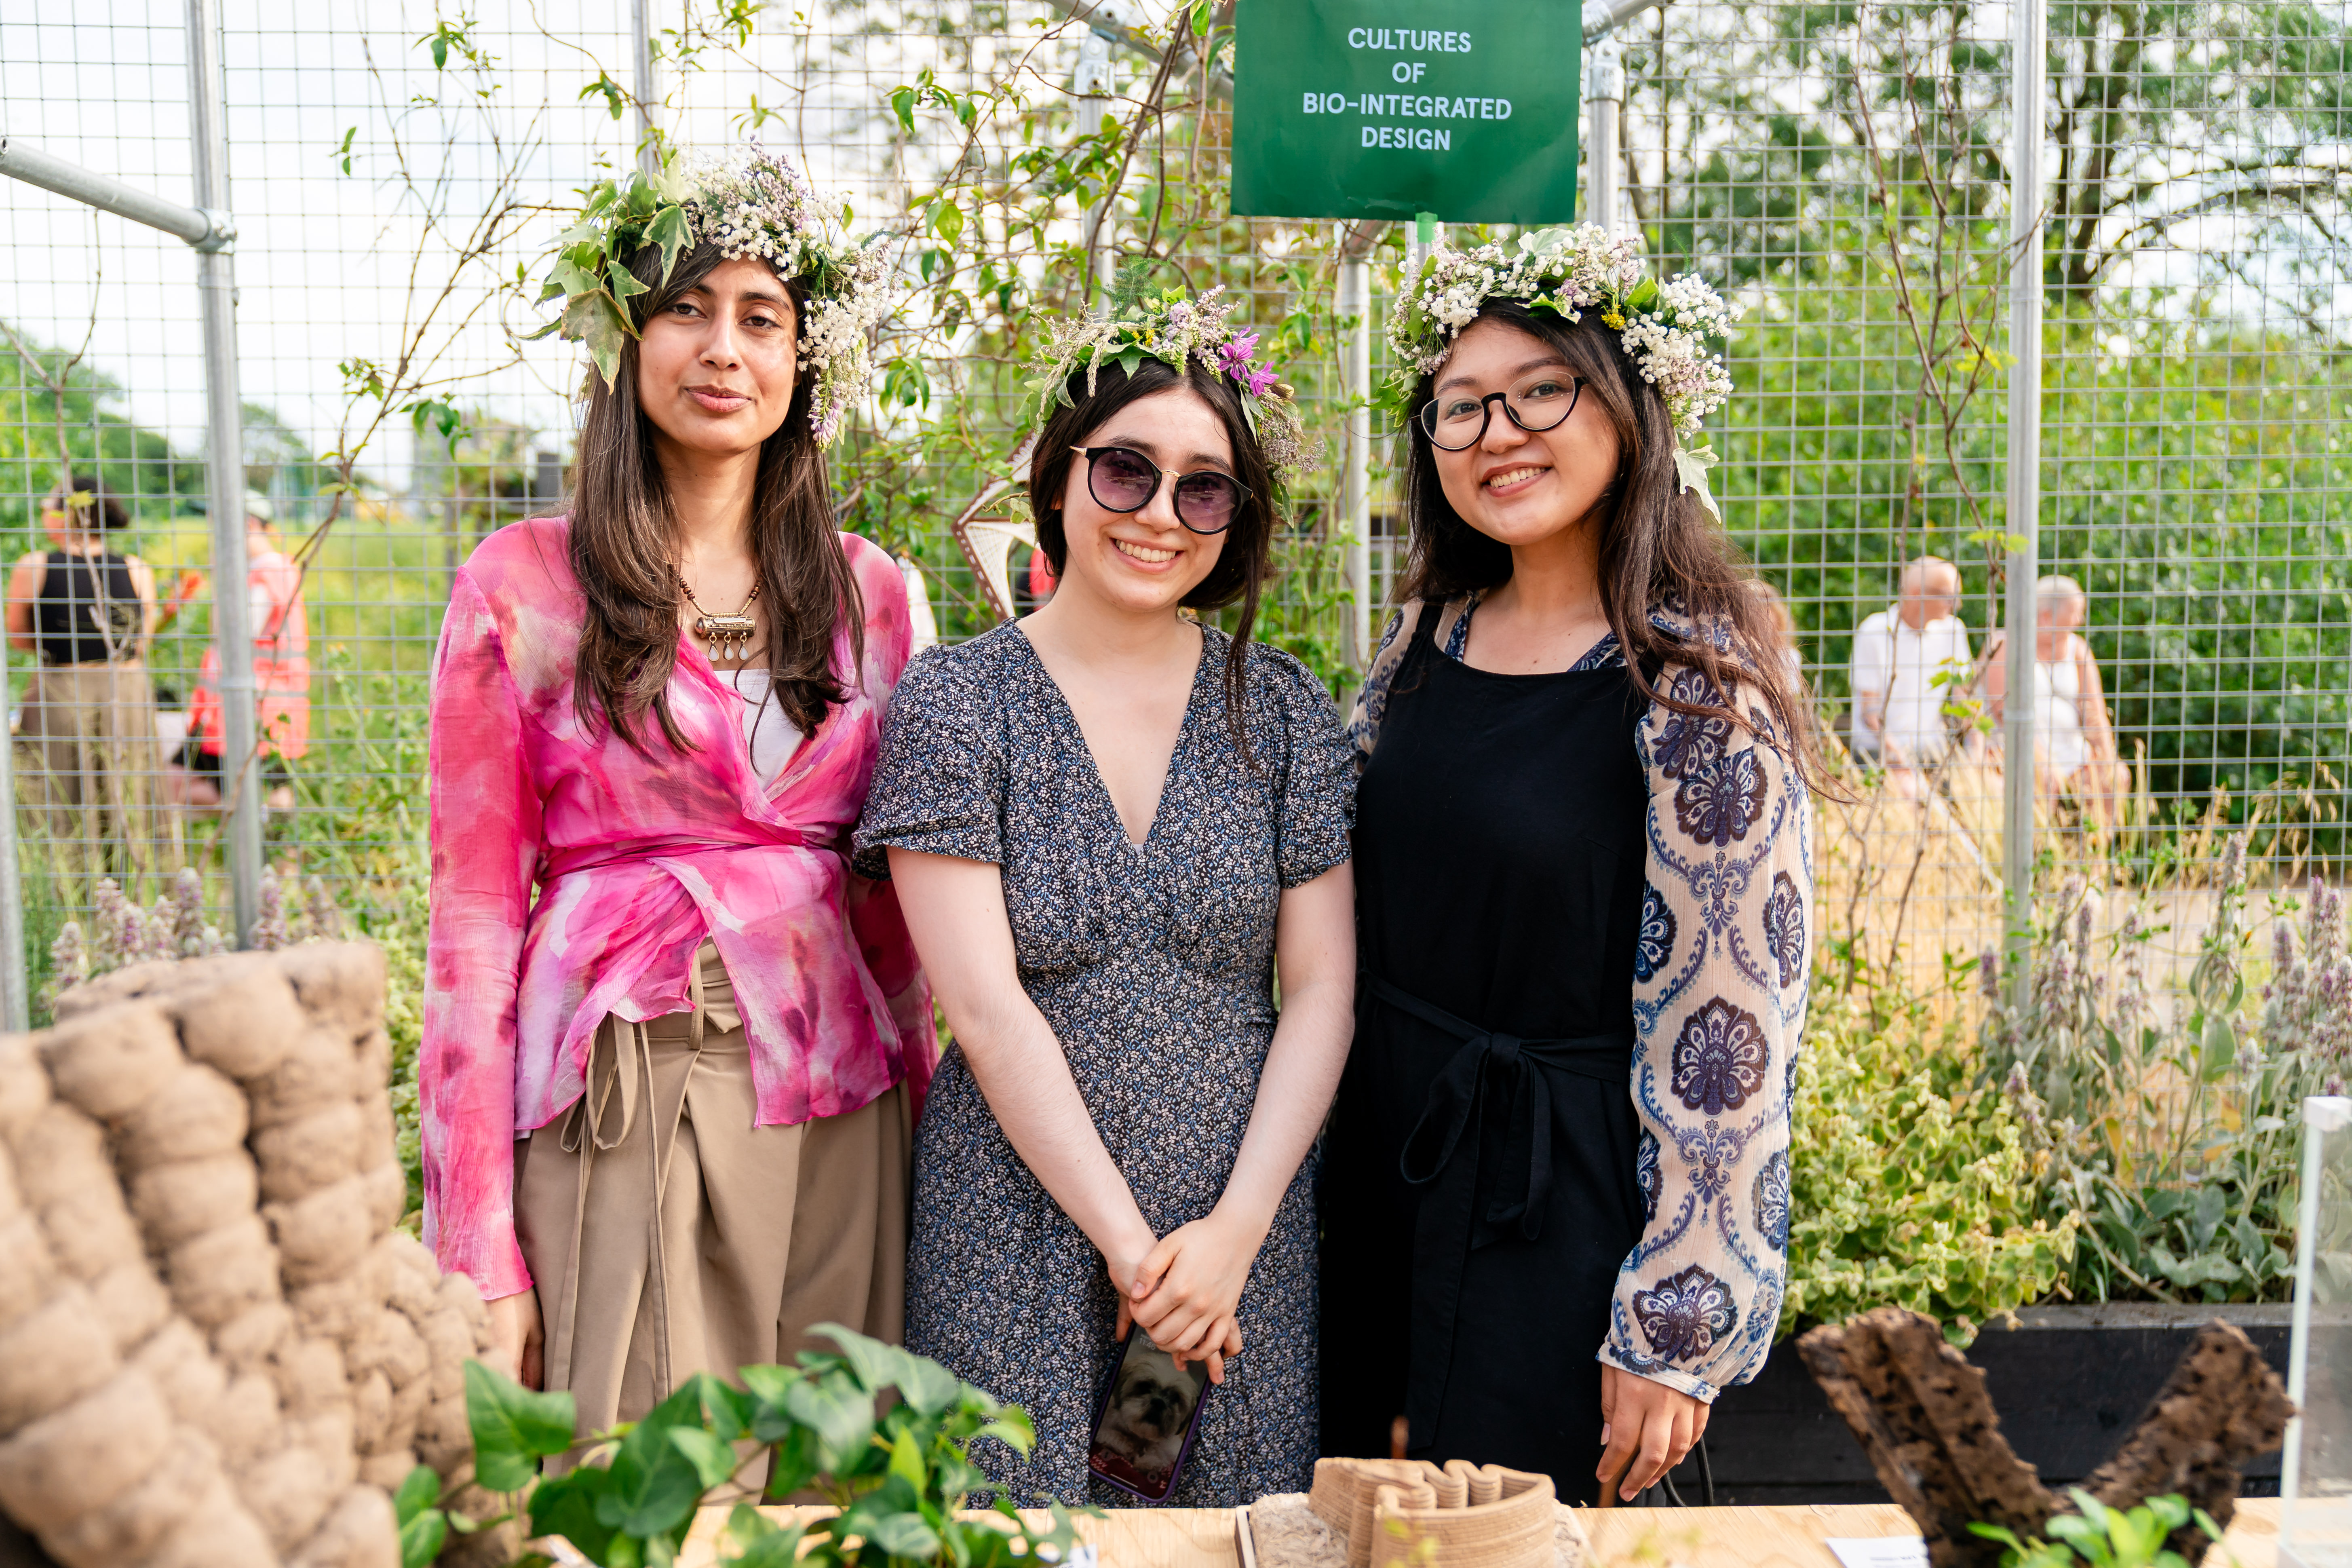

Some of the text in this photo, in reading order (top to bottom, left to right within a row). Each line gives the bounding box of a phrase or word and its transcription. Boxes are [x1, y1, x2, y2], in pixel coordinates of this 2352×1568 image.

[1348, 27, 1472, 53] CULTURES
[1392, 61, 1427, 84] OF
[1303, 92, 1512, 120] BIO-INTEGRATED
[1361, 126, 1451, 151] DESIGN
[1139, 1338, 1156, 1350] 11:46
